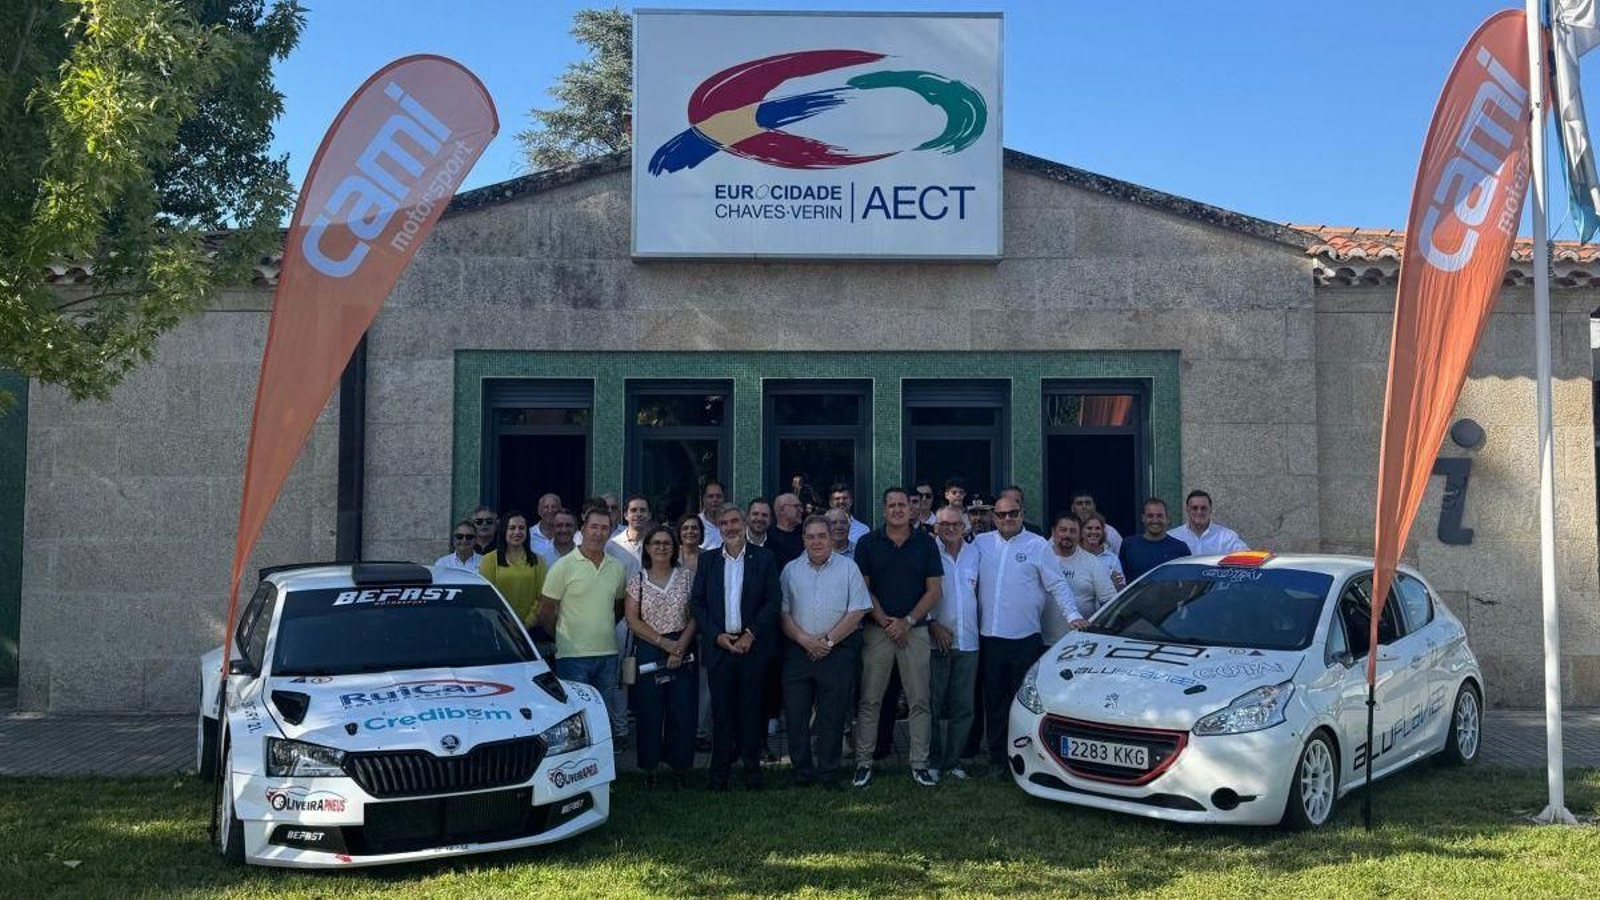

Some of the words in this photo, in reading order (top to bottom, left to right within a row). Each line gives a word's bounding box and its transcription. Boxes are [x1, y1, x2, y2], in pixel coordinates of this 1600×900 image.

[301, 81, 452, 278] cami
[390, 139, 474, 251] motorsport
[714, 184, 842, 201] EUROCIDADE
[861, 185, 976, 221] AECT
[332, 587, 463, 606] BEFAST
[1056, 641, 1099, 662] 23
[364, 708, 513, 731] Credibom
[1071, 741, 1108, 761] 2283
[1113, 746, 1145, 766] KKG
[287, 830, 326, 841] BEFAST
